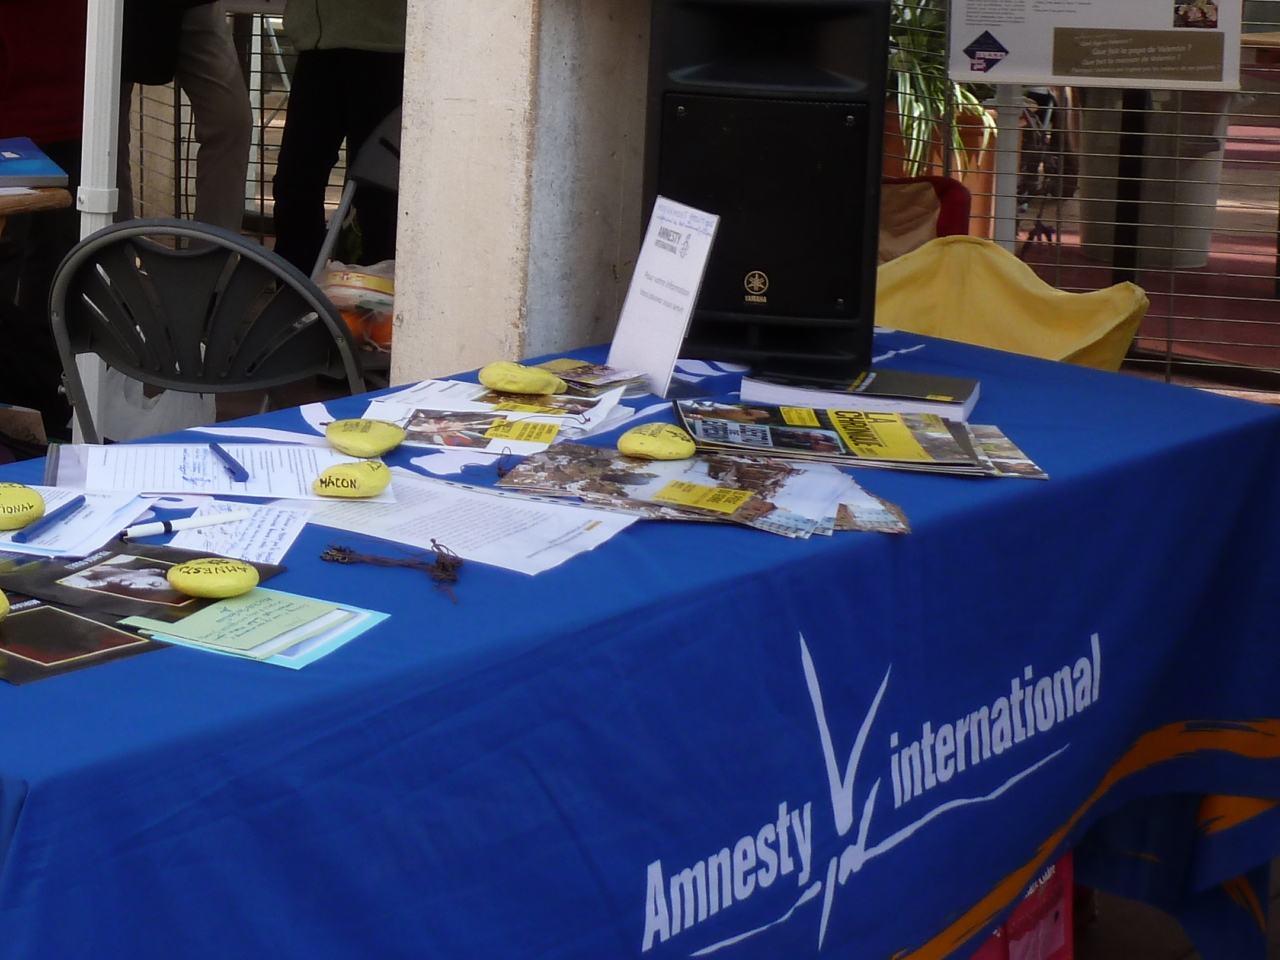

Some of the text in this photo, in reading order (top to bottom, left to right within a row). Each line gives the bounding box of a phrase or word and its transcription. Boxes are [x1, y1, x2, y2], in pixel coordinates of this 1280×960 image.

[744, 295, 767, 303] YAMAHA
[864, 412, 897, 425] LA
[833, 410, 883, 448] CHRONIQUE
[320, 476, 357, 489] MÂCON
[641, 633, 1102, 952] Amnesty international
